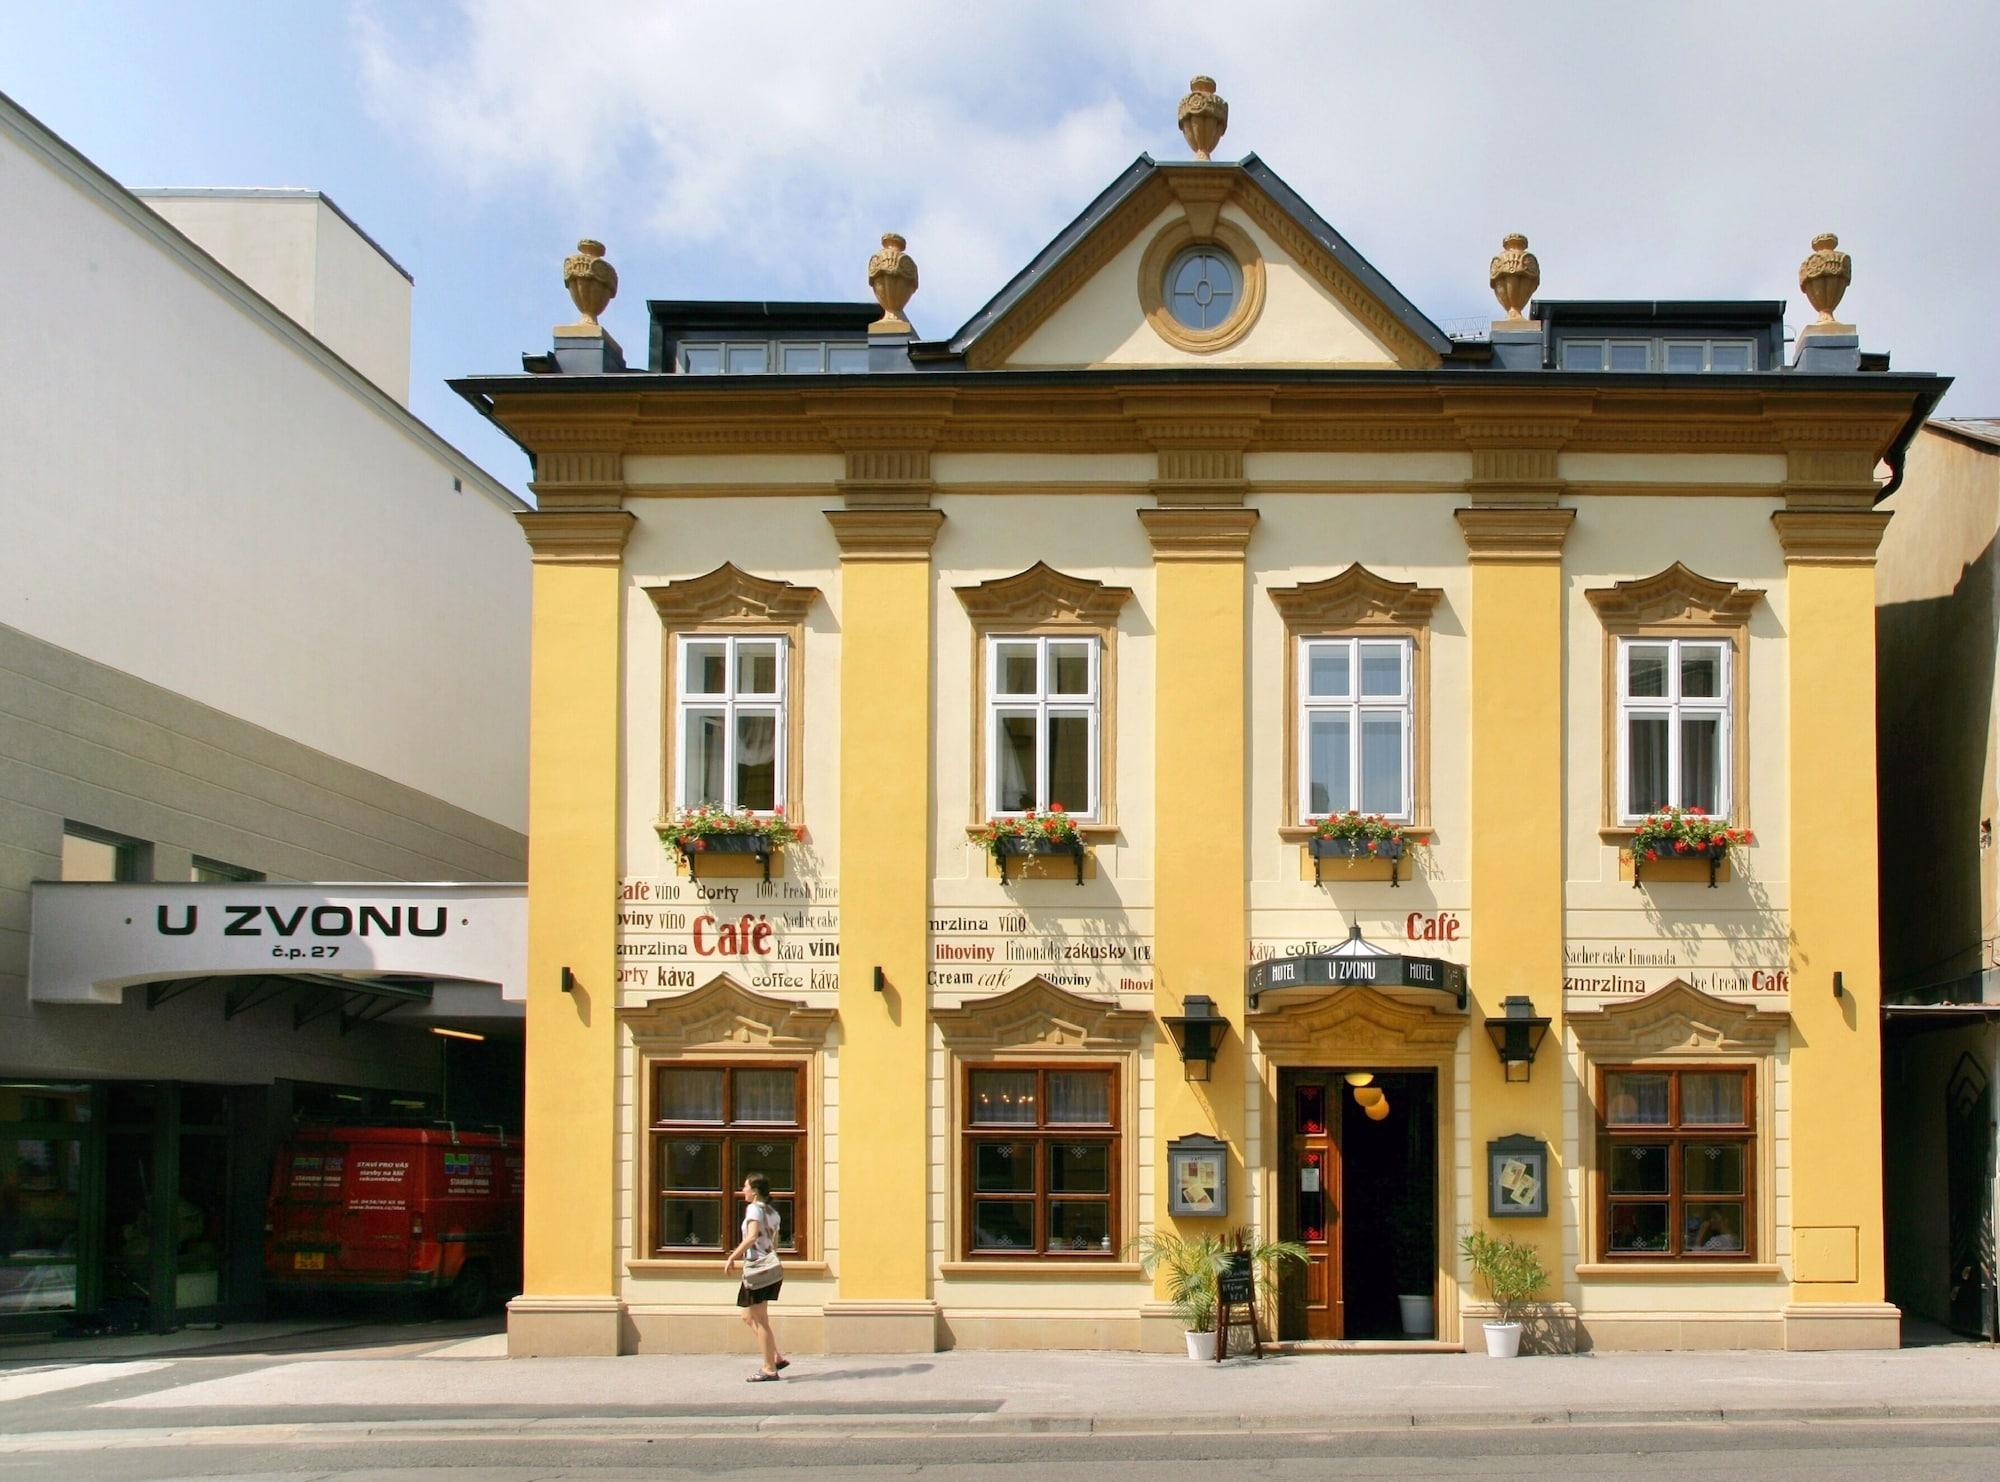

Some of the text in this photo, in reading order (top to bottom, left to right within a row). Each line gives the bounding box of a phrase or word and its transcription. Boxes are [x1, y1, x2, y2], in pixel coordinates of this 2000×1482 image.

[697, 885, 739, 903] dorty
[783, 882, 812, 899] Fresh
[157, 905, 448, 937] U ZVONU
[783, 911, 838, 928] Sacher cake
[1407, 912, 1460, 941] Café
[693, 914, 772, 956] Café
[272, 944, 340, 960] č.p. 27
[616, 941, 688, 956] zmrzlina
[777, 940, 804, 960] káva
[936, 944, 995, 962] lihoviny
[1064, 943, 1126, 959] zákusky
[1133, 946, 1151, 961] ICE
[1249, 941, 1276, 961] káva
[1564, 945, 1676, 965] Sacher cake limonada
[657, 966, 695, 987] káva
[752, 967, 839, 990] coffee káva
[927, 967, 1013, 991] Cream café
[1271, 963, 1296, 982] HOTEL
[1328, 961, 1376, 980] U ZVONU
[1409, 963, 1434, 981] HOTEL
[1562, 975, 1646, 993] zmrzlina
[1712, 972, 1748, 991] Cream
